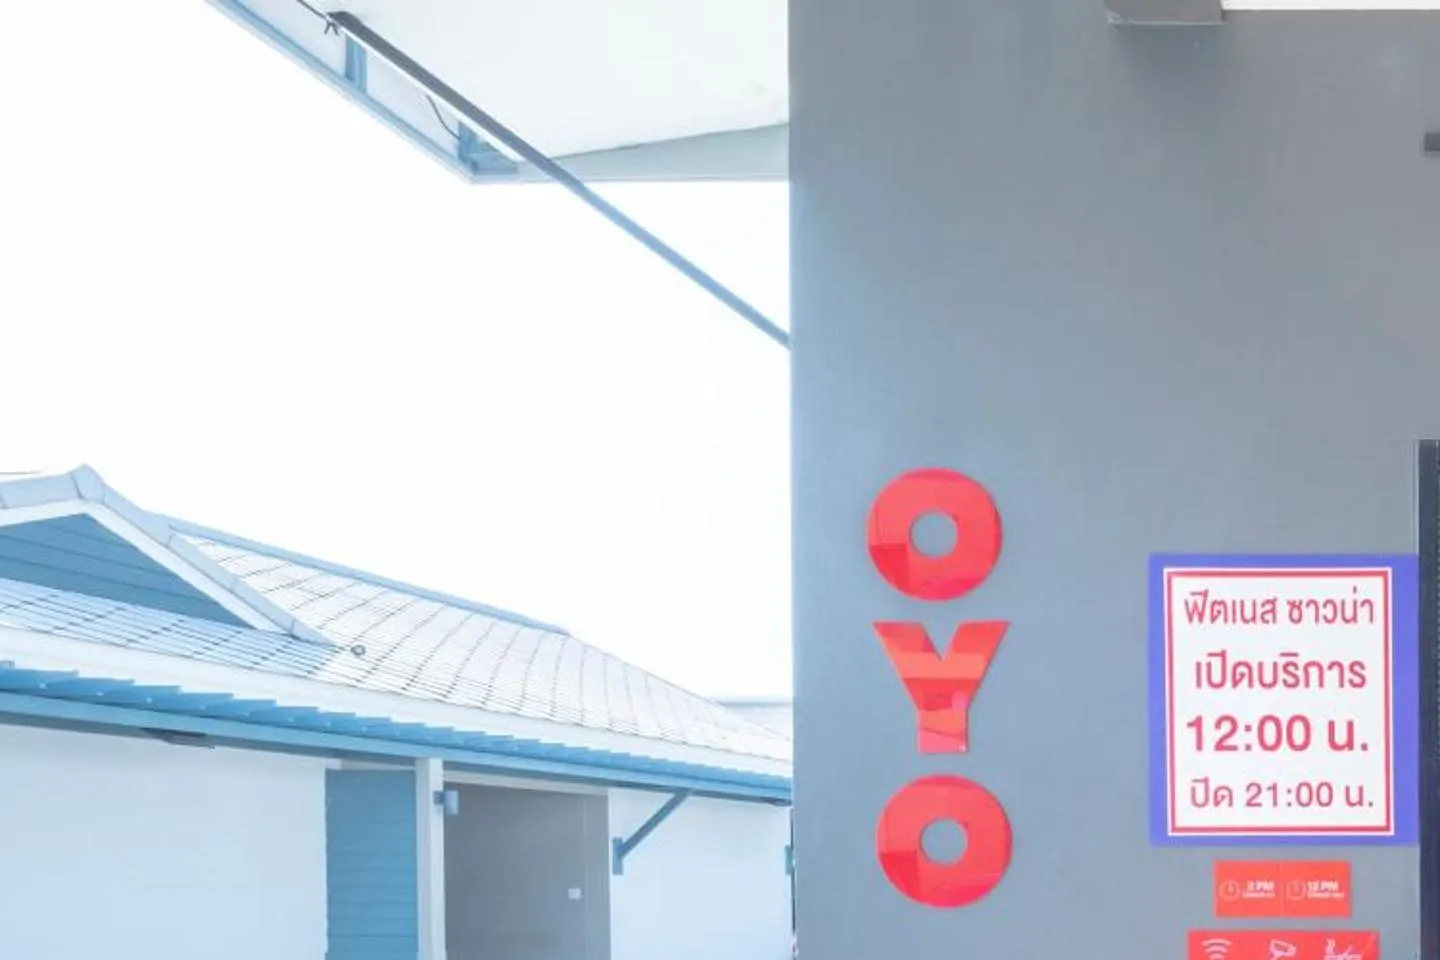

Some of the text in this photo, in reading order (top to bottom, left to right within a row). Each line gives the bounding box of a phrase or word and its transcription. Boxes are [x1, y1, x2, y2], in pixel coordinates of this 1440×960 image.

[1184, 586, 1374, 625] ฟิตเนส ซาวน่า
[866, 467, 1014, 909] OYO
[1195, 650, 1366, 689] เปิดบริการ
[1186, 714, 1368, 752] 12:00 น.
[1190, 777, 1374, 808] ปิด 21:00 น.
